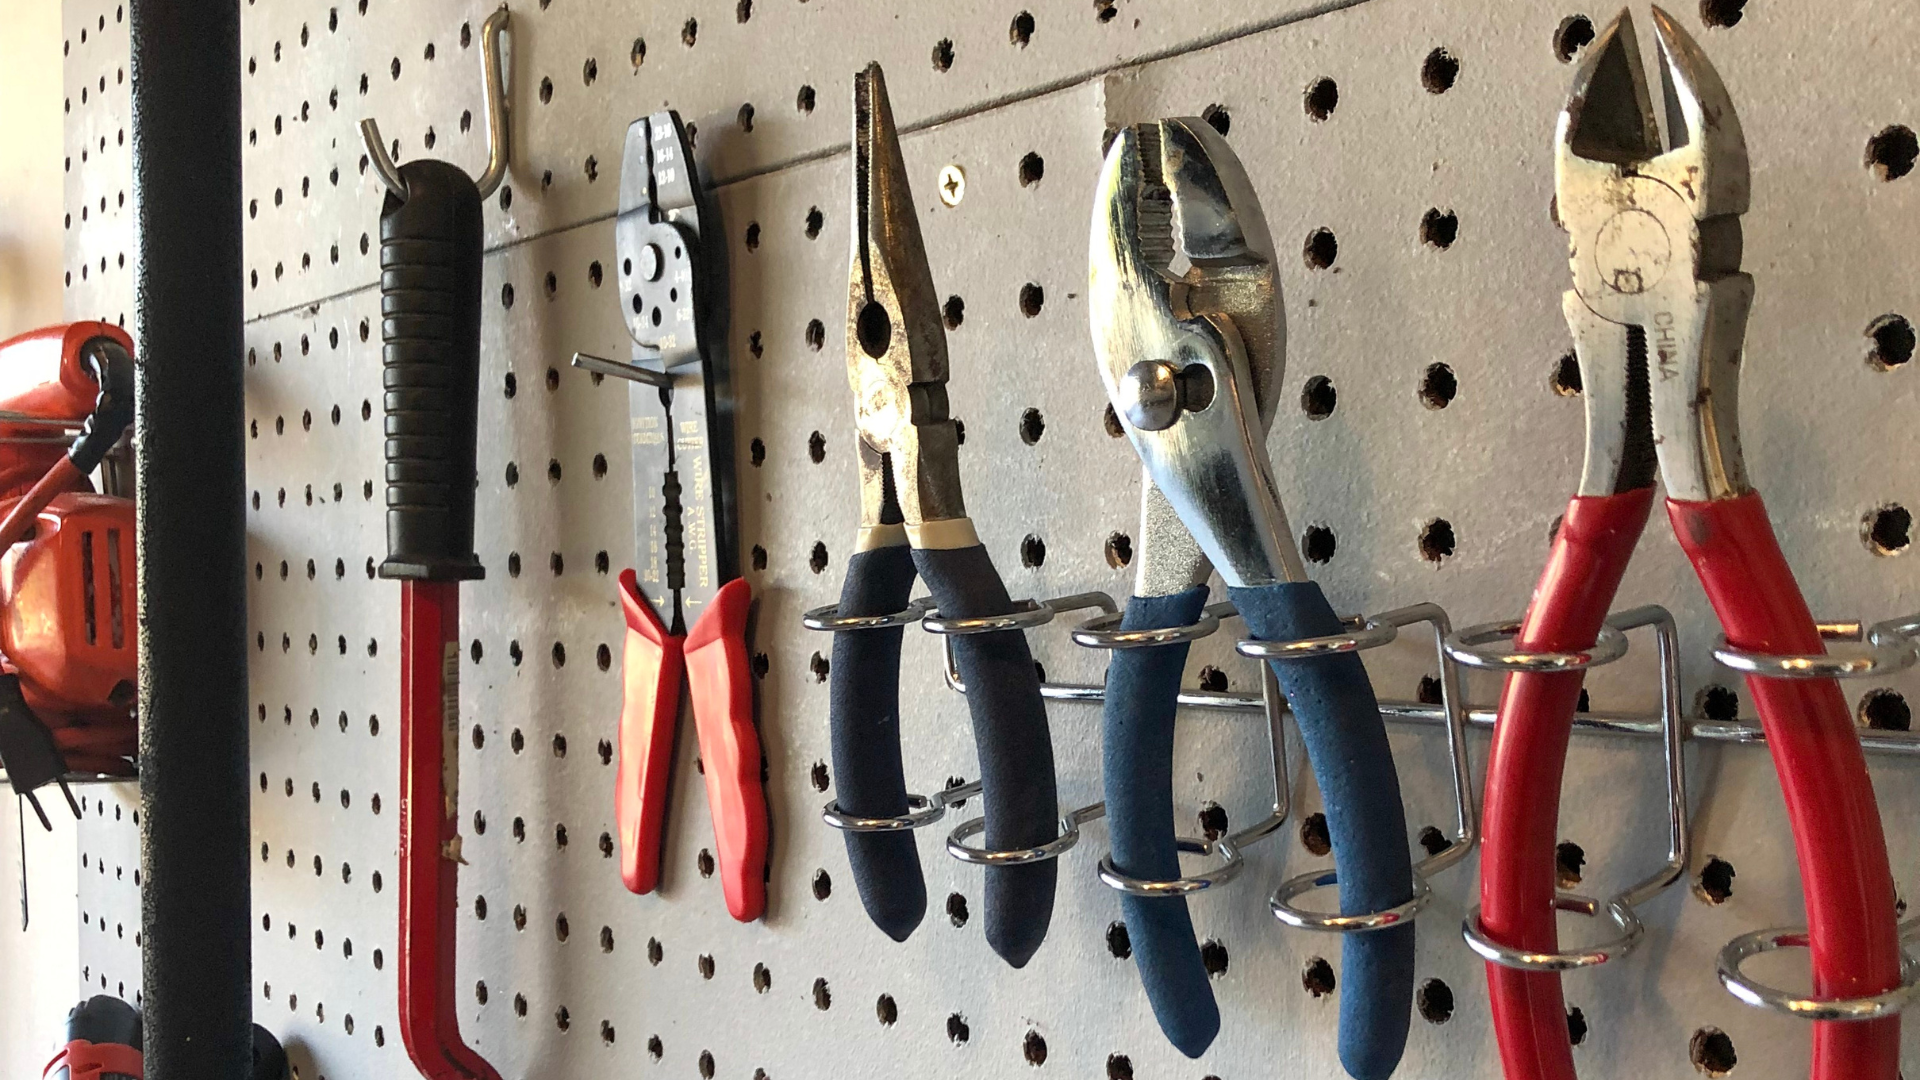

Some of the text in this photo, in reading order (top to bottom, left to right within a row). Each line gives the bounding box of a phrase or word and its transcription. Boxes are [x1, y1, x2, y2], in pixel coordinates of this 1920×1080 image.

[1653, 311, 1680, 383] CHINA
[692, 455, 709, 587] WIRE STRIPPER
